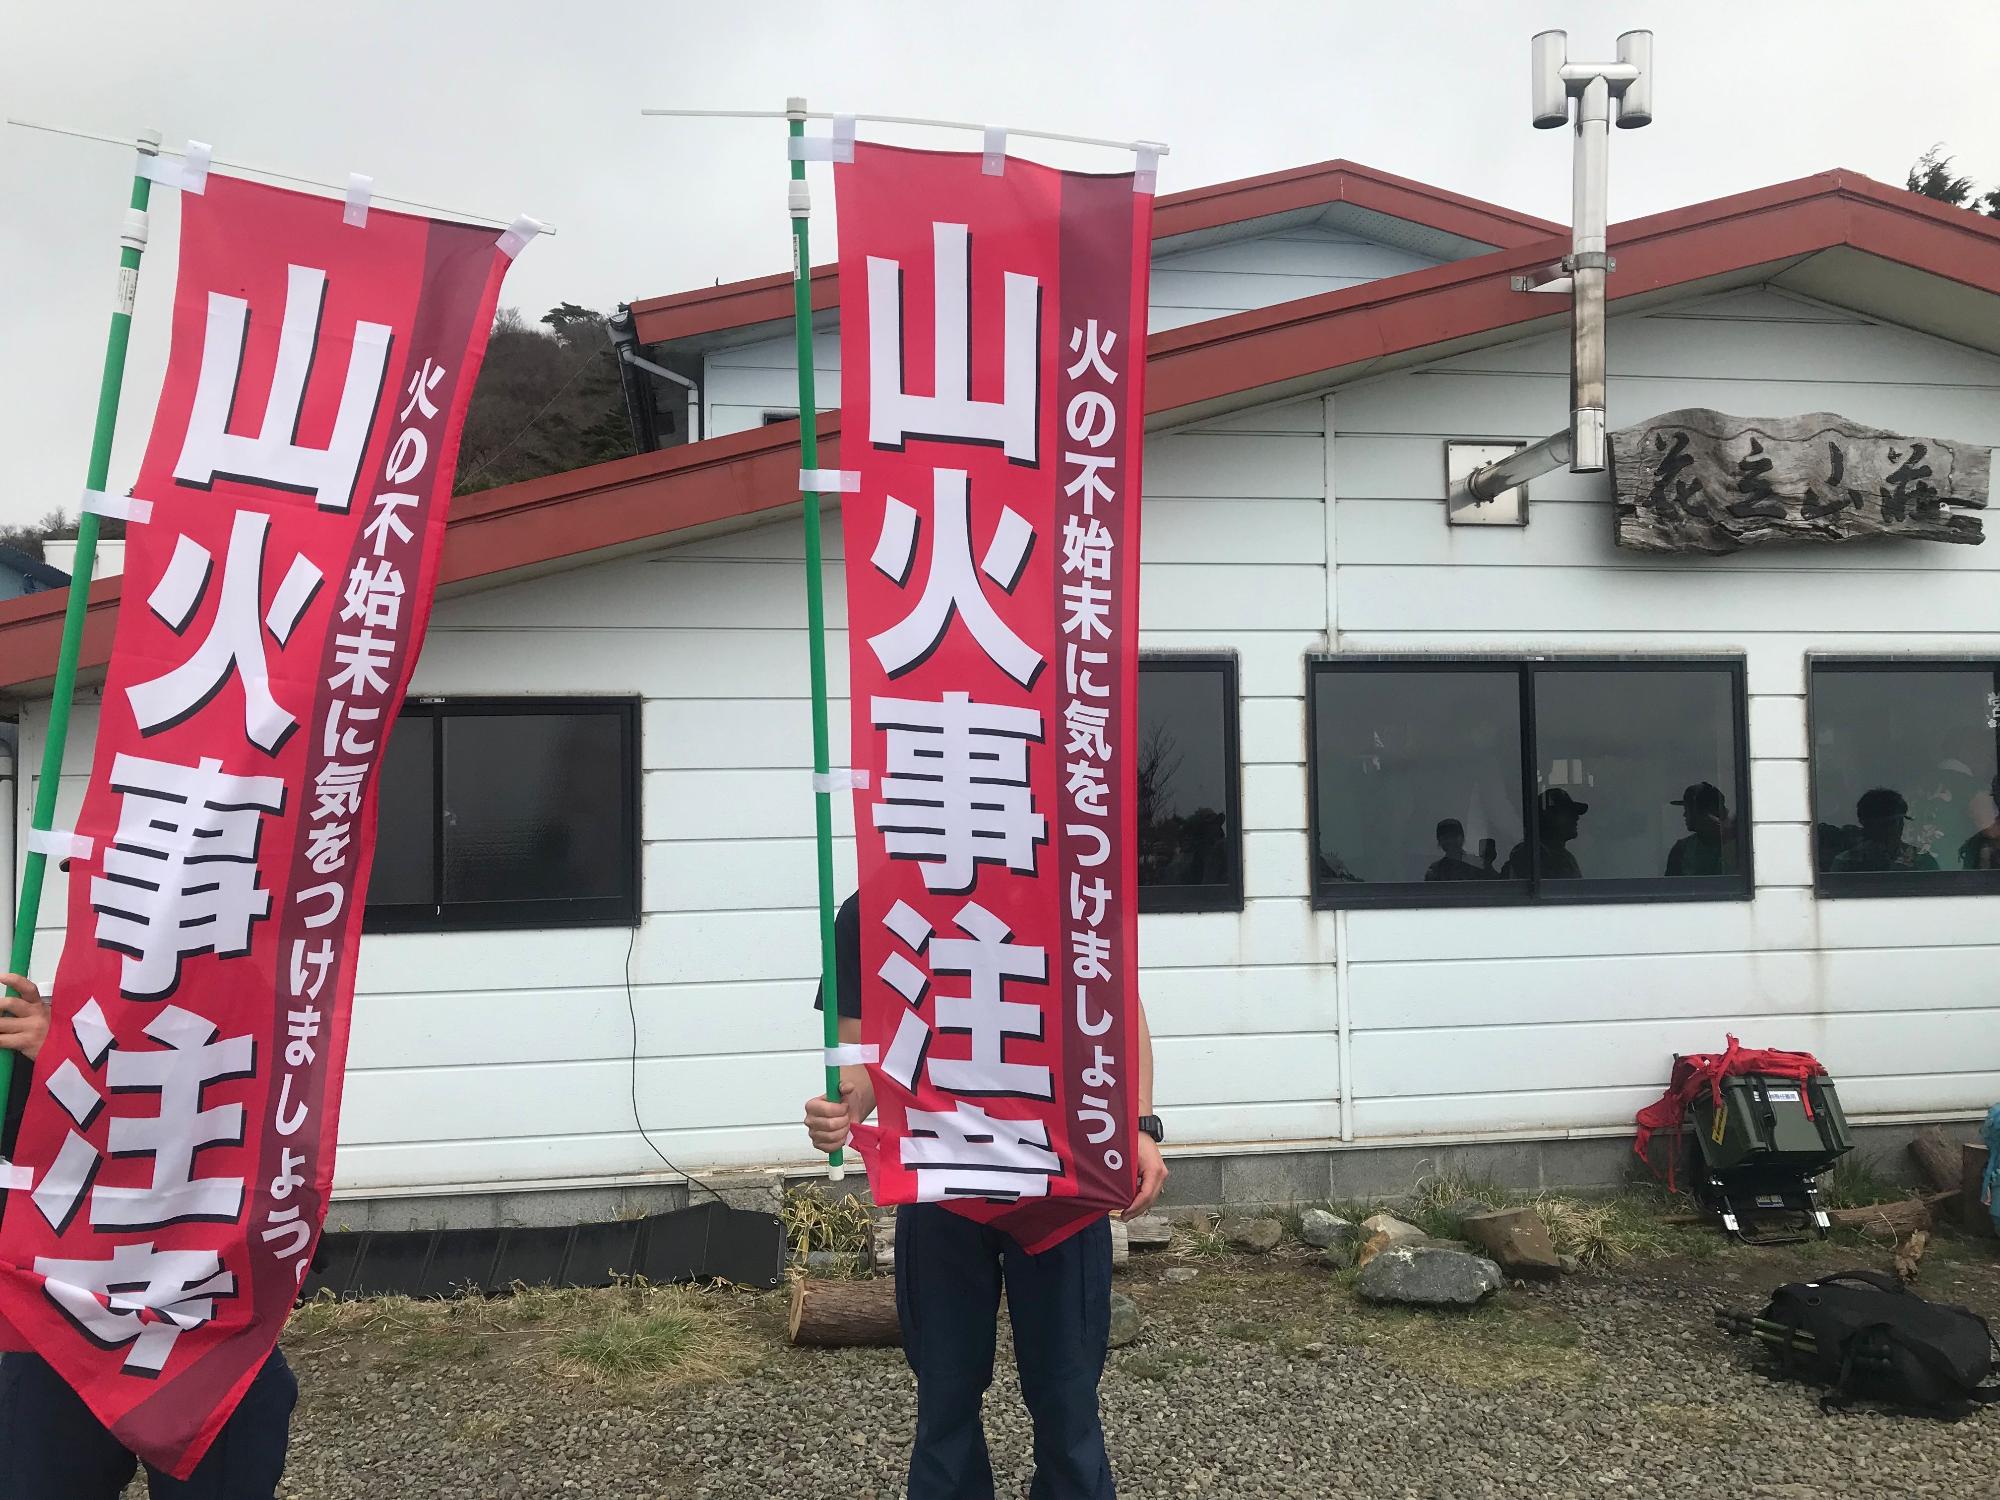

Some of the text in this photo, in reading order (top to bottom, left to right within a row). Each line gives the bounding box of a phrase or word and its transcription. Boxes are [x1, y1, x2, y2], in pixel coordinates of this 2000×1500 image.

[1061, 318, 1123, 1171] 火の不始末に気をつけましょう。
